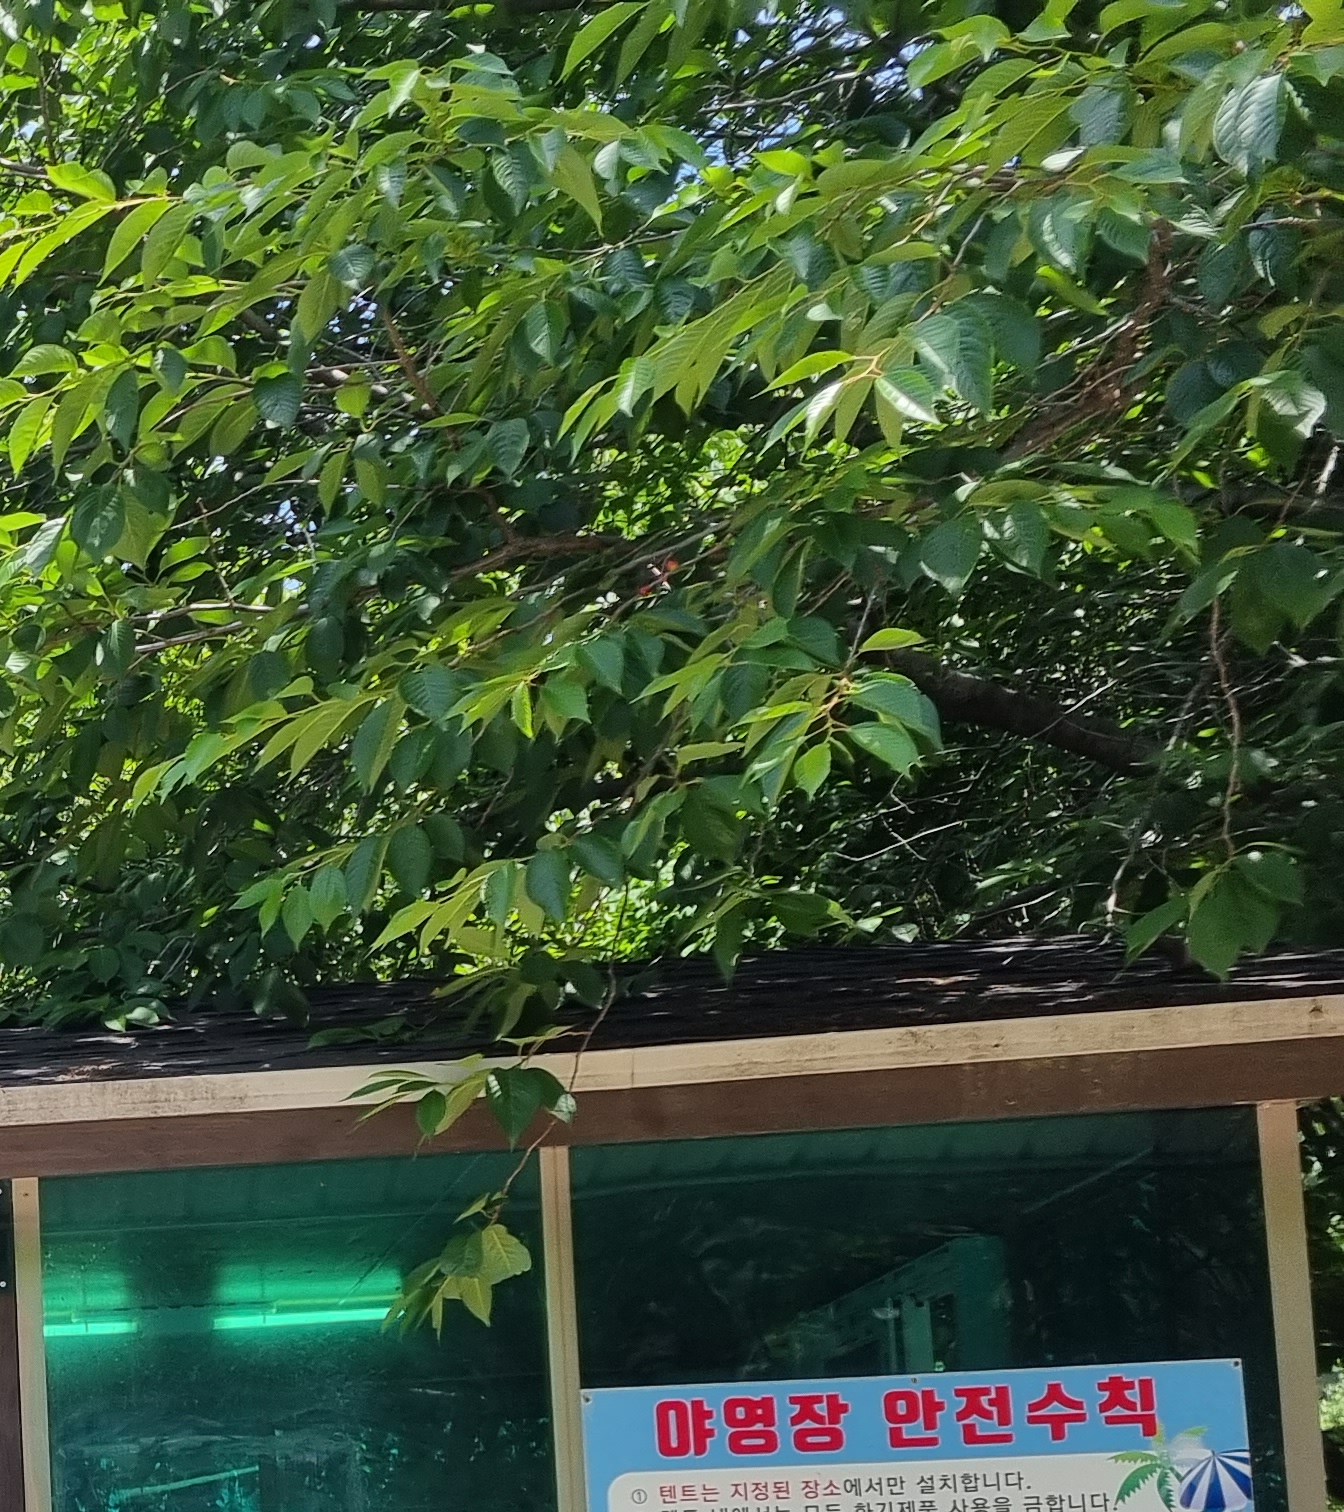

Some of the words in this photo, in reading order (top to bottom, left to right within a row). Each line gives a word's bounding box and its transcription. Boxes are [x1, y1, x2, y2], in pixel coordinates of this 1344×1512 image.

[654, 1392, 853, 1458] 야영장
[882, 1375, 1159, 1449] 안전수칙
[659, 1483, 721, 1504] 텐트는
[730, 1480, 791, 1501] 지정된
[801, 1475, 906, 1499] 장소에서만
[916, 1471, 1032, 1495] 설치합니다.
